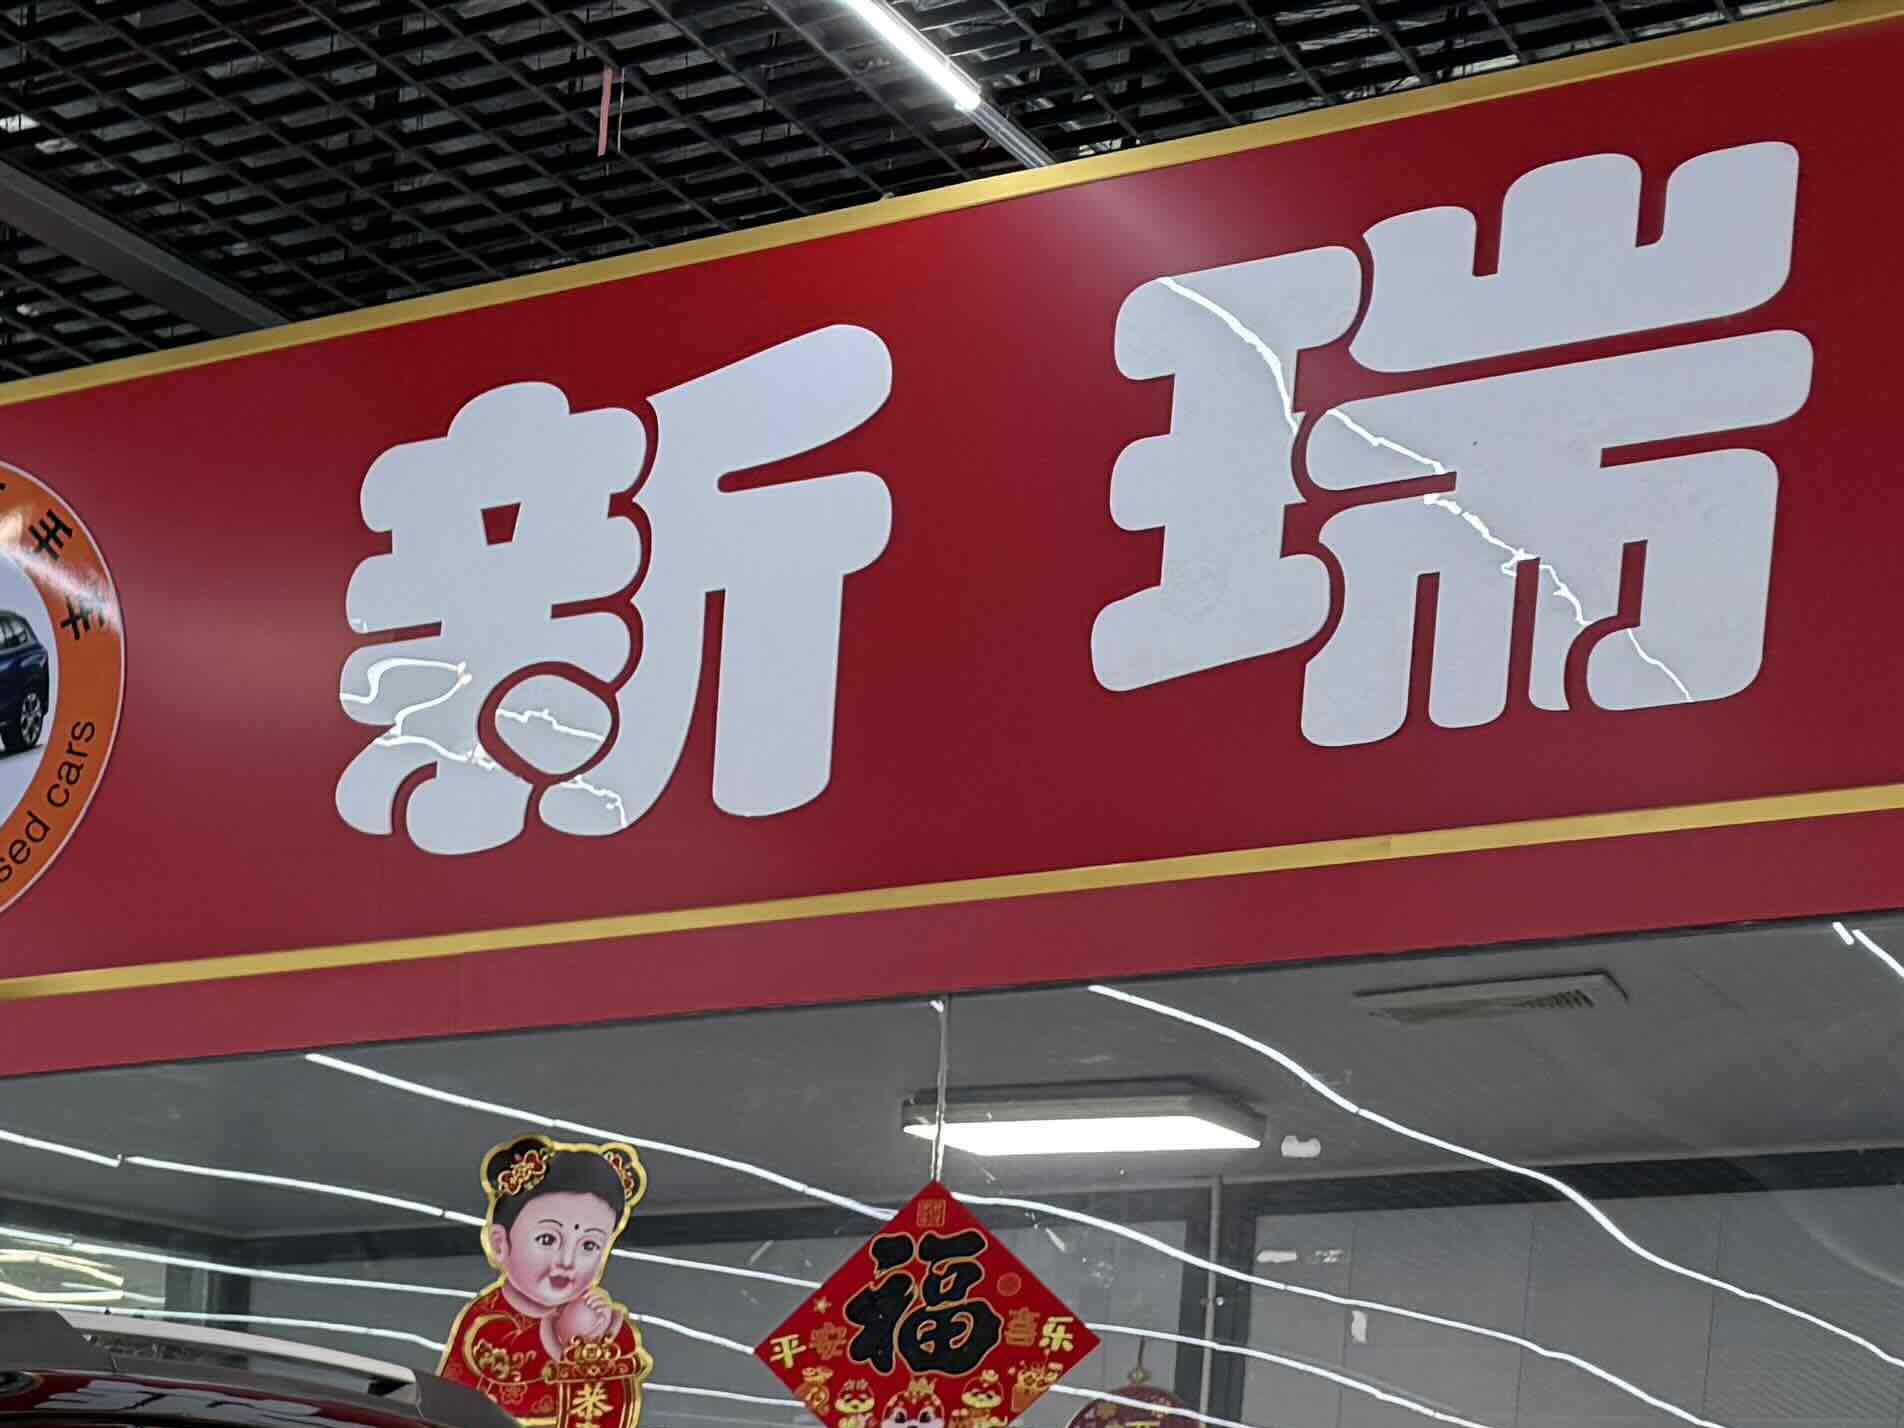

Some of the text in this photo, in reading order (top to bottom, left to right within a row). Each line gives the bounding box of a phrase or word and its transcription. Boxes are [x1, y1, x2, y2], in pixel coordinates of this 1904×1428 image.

[335, 140, 1813, 854] 新瑞
[46, 719, 97, 809] cars
[844, 1228, 1004, 1376] 福
